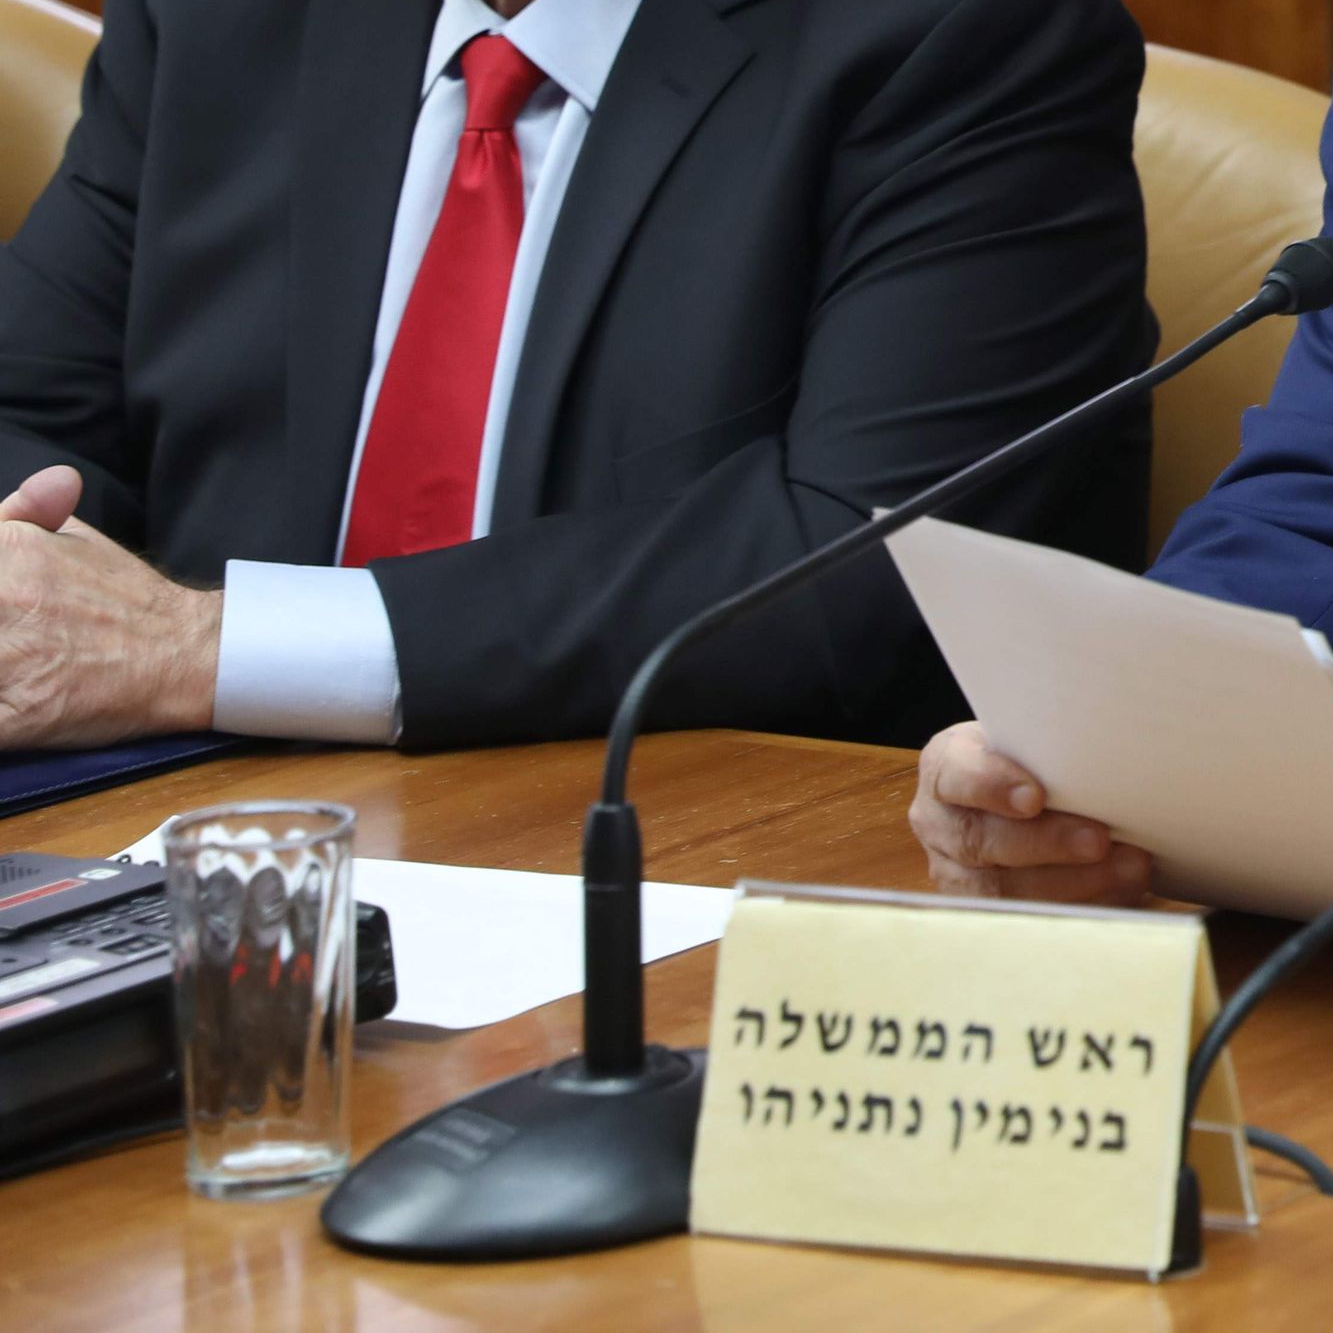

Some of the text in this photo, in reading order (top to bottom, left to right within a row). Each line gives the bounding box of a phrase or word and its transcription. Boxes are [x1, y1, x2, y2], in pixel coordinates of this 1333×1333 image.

[734, 999, 1155, 1077] ראש הממשלה
[738, 1082, 1128, 1153] בנימין נתניהו
